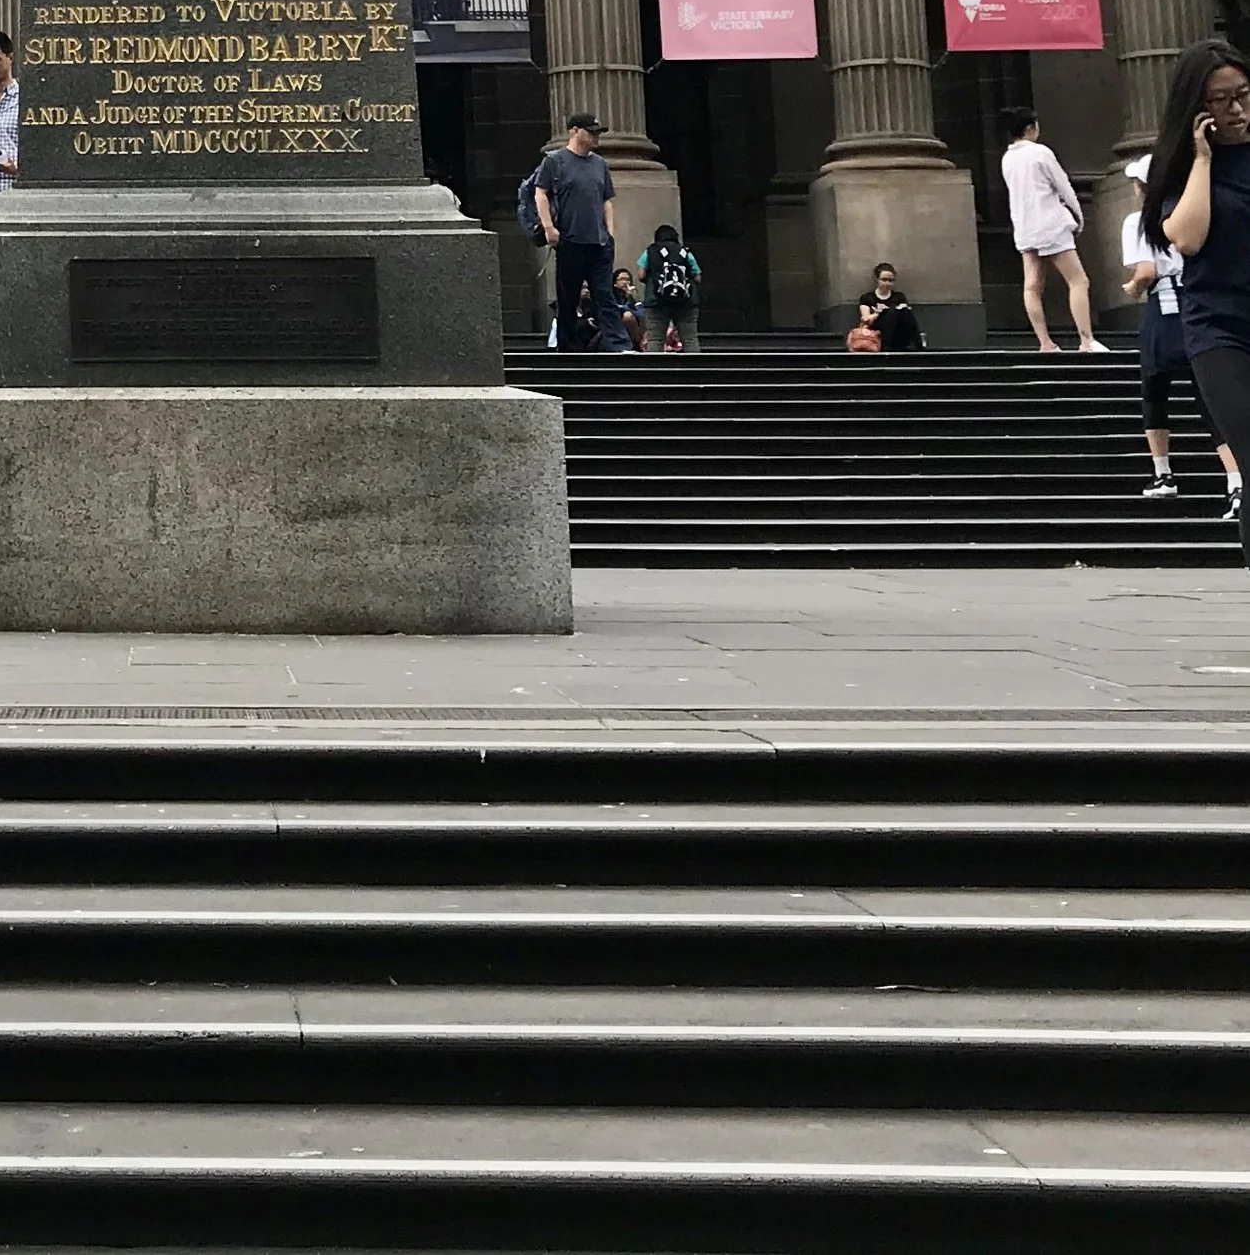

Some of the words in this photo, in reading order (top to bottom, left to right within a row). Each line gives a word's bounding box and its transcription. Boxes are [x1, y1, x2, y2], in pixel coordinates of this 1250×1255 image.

[34, 5, 166, 25] RENDERED
[176, 5, 206, 23] TO
[364, 2, 398, 21] BY
[710, 20, 764, 31] VICTORIA
[717, 10, 748, 21] STATE
[751, 9, 795, 20] LIBRARY
[23, 36, 86, 65] SIR
[89, 35, 246, 64] REDMOND
[248, 34, 366, 62] BARRY
[111, 69, 205, 94] DOCTOR
[213, 75, 241, 93] OF
[247, 68, 322, 93] LAWS
[21, 107, 68, 125] AND
[69, 107, 88, 125] A
[90, 100, 160, 125] JUDGE
[163, 106, 187, 124] OF
[189, 105, 234, 124] THE
[237, 98, 342, 123] SUPREME
[344, 97, 416, 123] COURT
